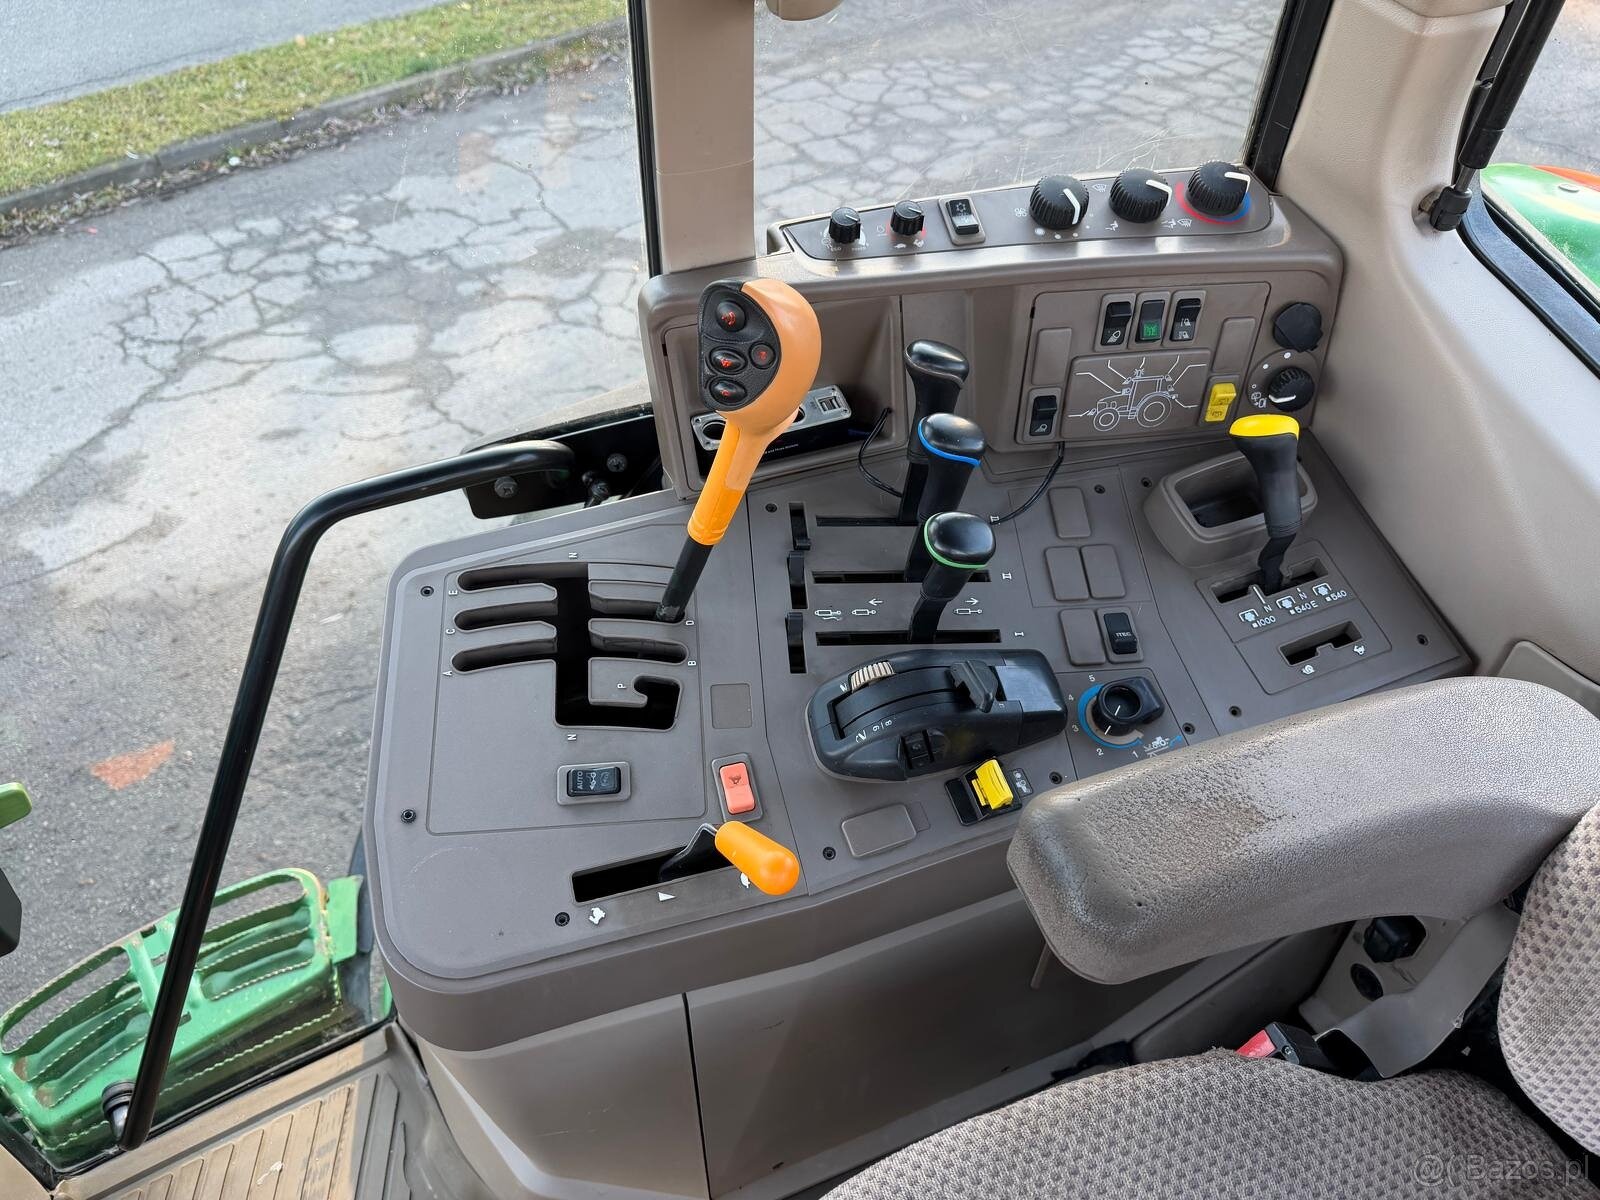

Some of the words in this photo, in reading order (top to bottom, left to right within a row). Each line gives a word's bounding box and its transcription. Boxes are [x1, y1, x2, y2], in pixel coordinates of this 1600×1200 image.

[1299, 592, 1308, 600] N
[1331, 590, 1347, 601] 540
[1264, 605, 1273, 613] N
[1257, 615, 1276, 628] 1000
[1088, 674, 1096, 682] 5
[1096, 748, 1104, 756] 2
[1132, 750, 1139, 758] 1
